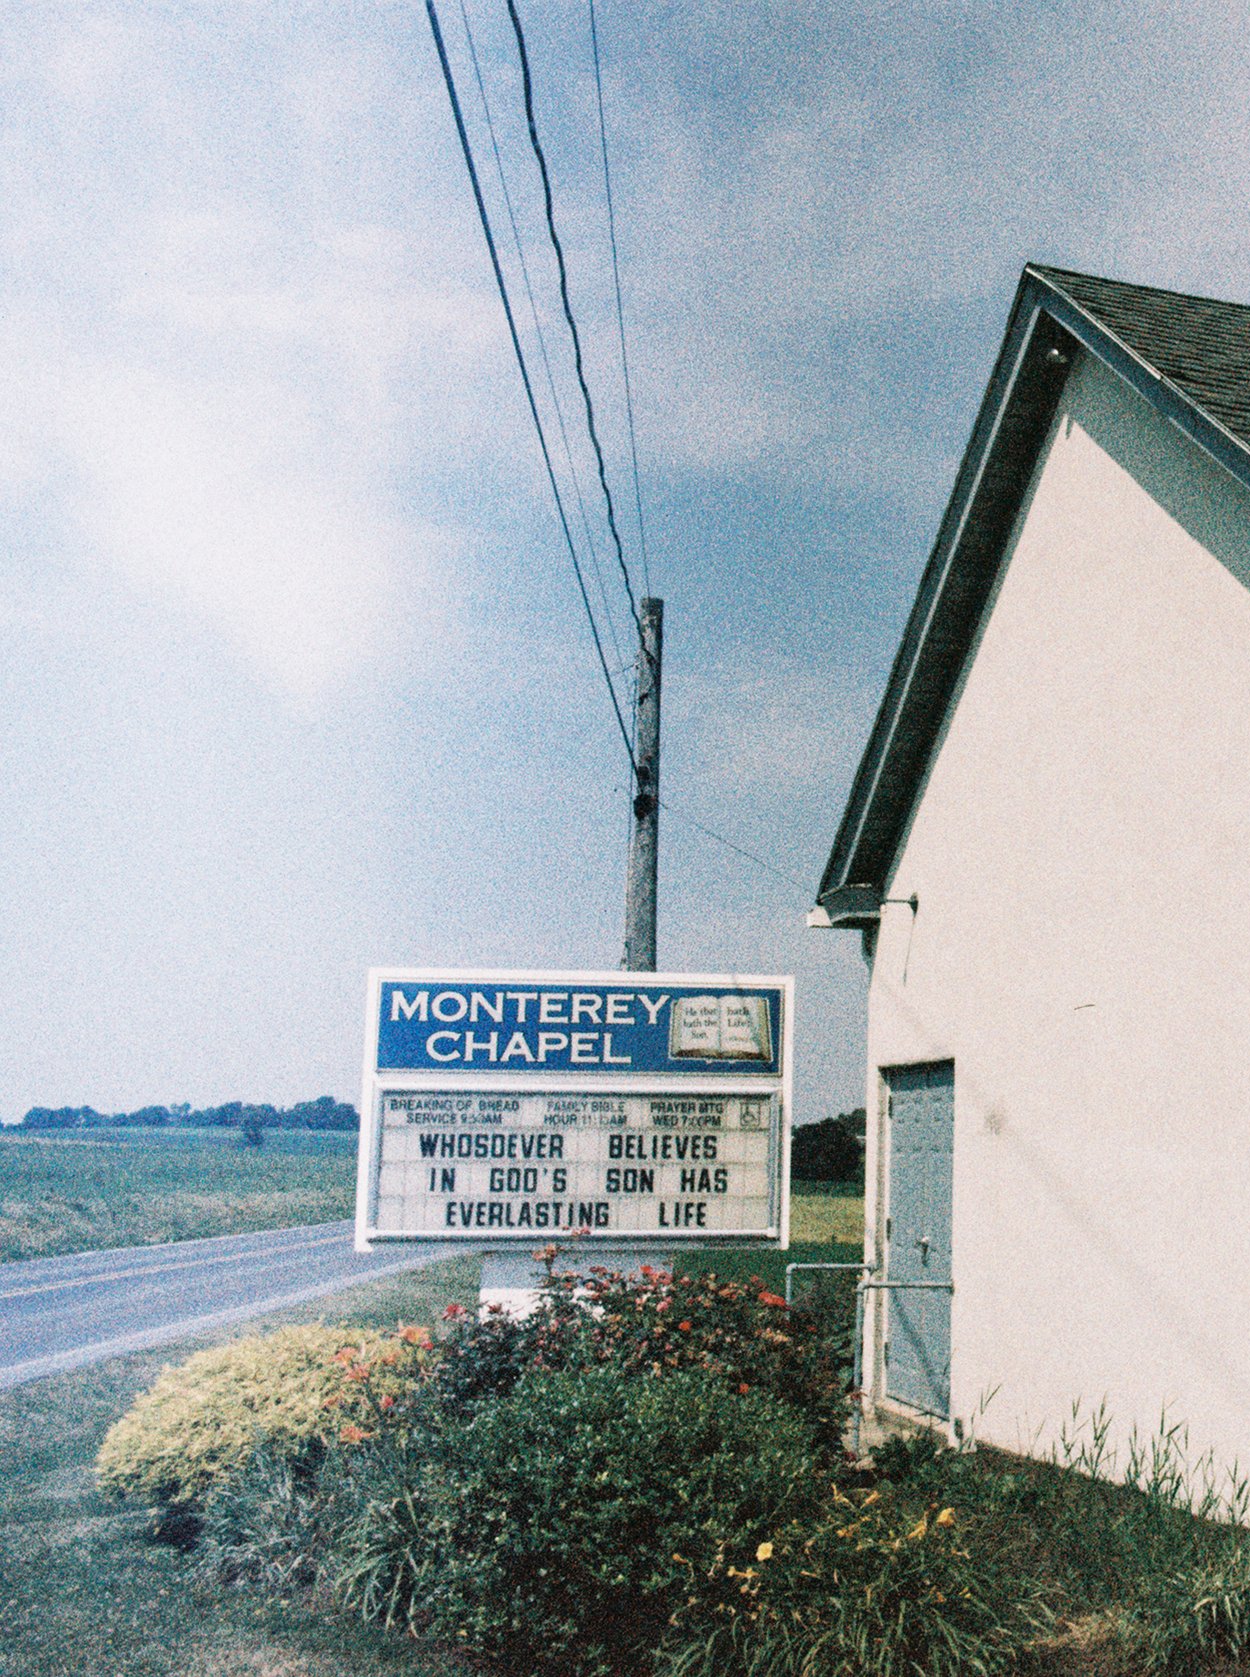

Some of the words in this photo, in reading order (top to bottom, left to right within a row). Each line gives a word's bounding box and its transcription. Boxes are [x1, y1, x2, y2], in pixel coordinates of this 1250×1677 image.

[390, 990, 670, 1025] MONTEREY
[425, 1030, 633, 1064] CHAPEL
[389, 1099, 450, 1111] BREAKING
[456, 1100, 472, 1111] OF
[478, 1100, 520, 1112] BREAD
[547, 1101, 587, 1112] FAMILY
[591, 1101, 625, 1112] BIBLE
[650, 1102, 695, 1113] PRAYER
[699, 1102, 724, 1114] MTG
[406, 1112, 456, 1124] SERVICE
[544, 1114, 577, 1125] HOUR
[652, 1115, 679, 1126] WED
[419, 1133, 564, 1159] WHOSOEVER
[608, 1134, 718, 1159] BELIEVES
[429, 1168, 456, 1192] IN
[489, 1168, 568, 1193] GOD'S
[605, 1169, 655, 1193] SON
[680, 1169, 729, 1194] HAS
[446, 1202, 610, 1228] EVERLASTING
[659, 1202, 707, 1227] LIFE
